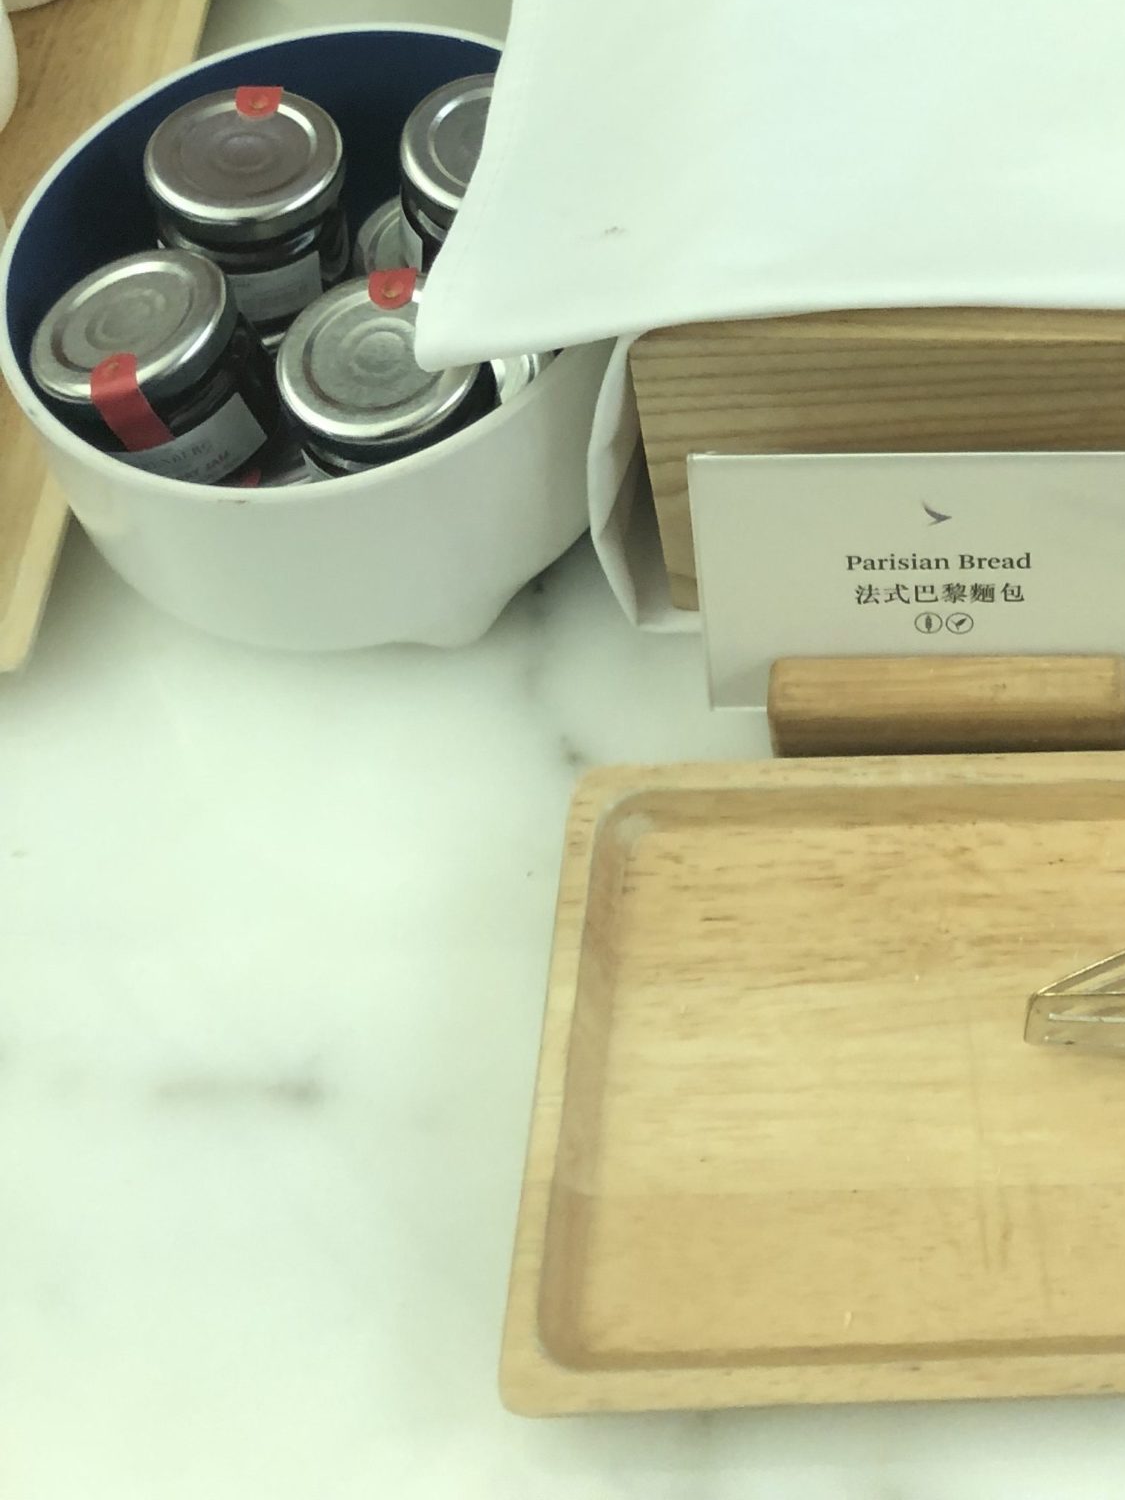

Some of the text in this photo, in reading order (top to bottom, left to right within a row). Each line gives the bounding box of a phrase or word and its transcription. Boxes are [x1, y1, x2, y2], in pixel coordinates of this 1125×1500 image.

[845, 552, 1032, 571] Parisian Bread
[854, 582, 1026, 606] 法式巴黎麵包
